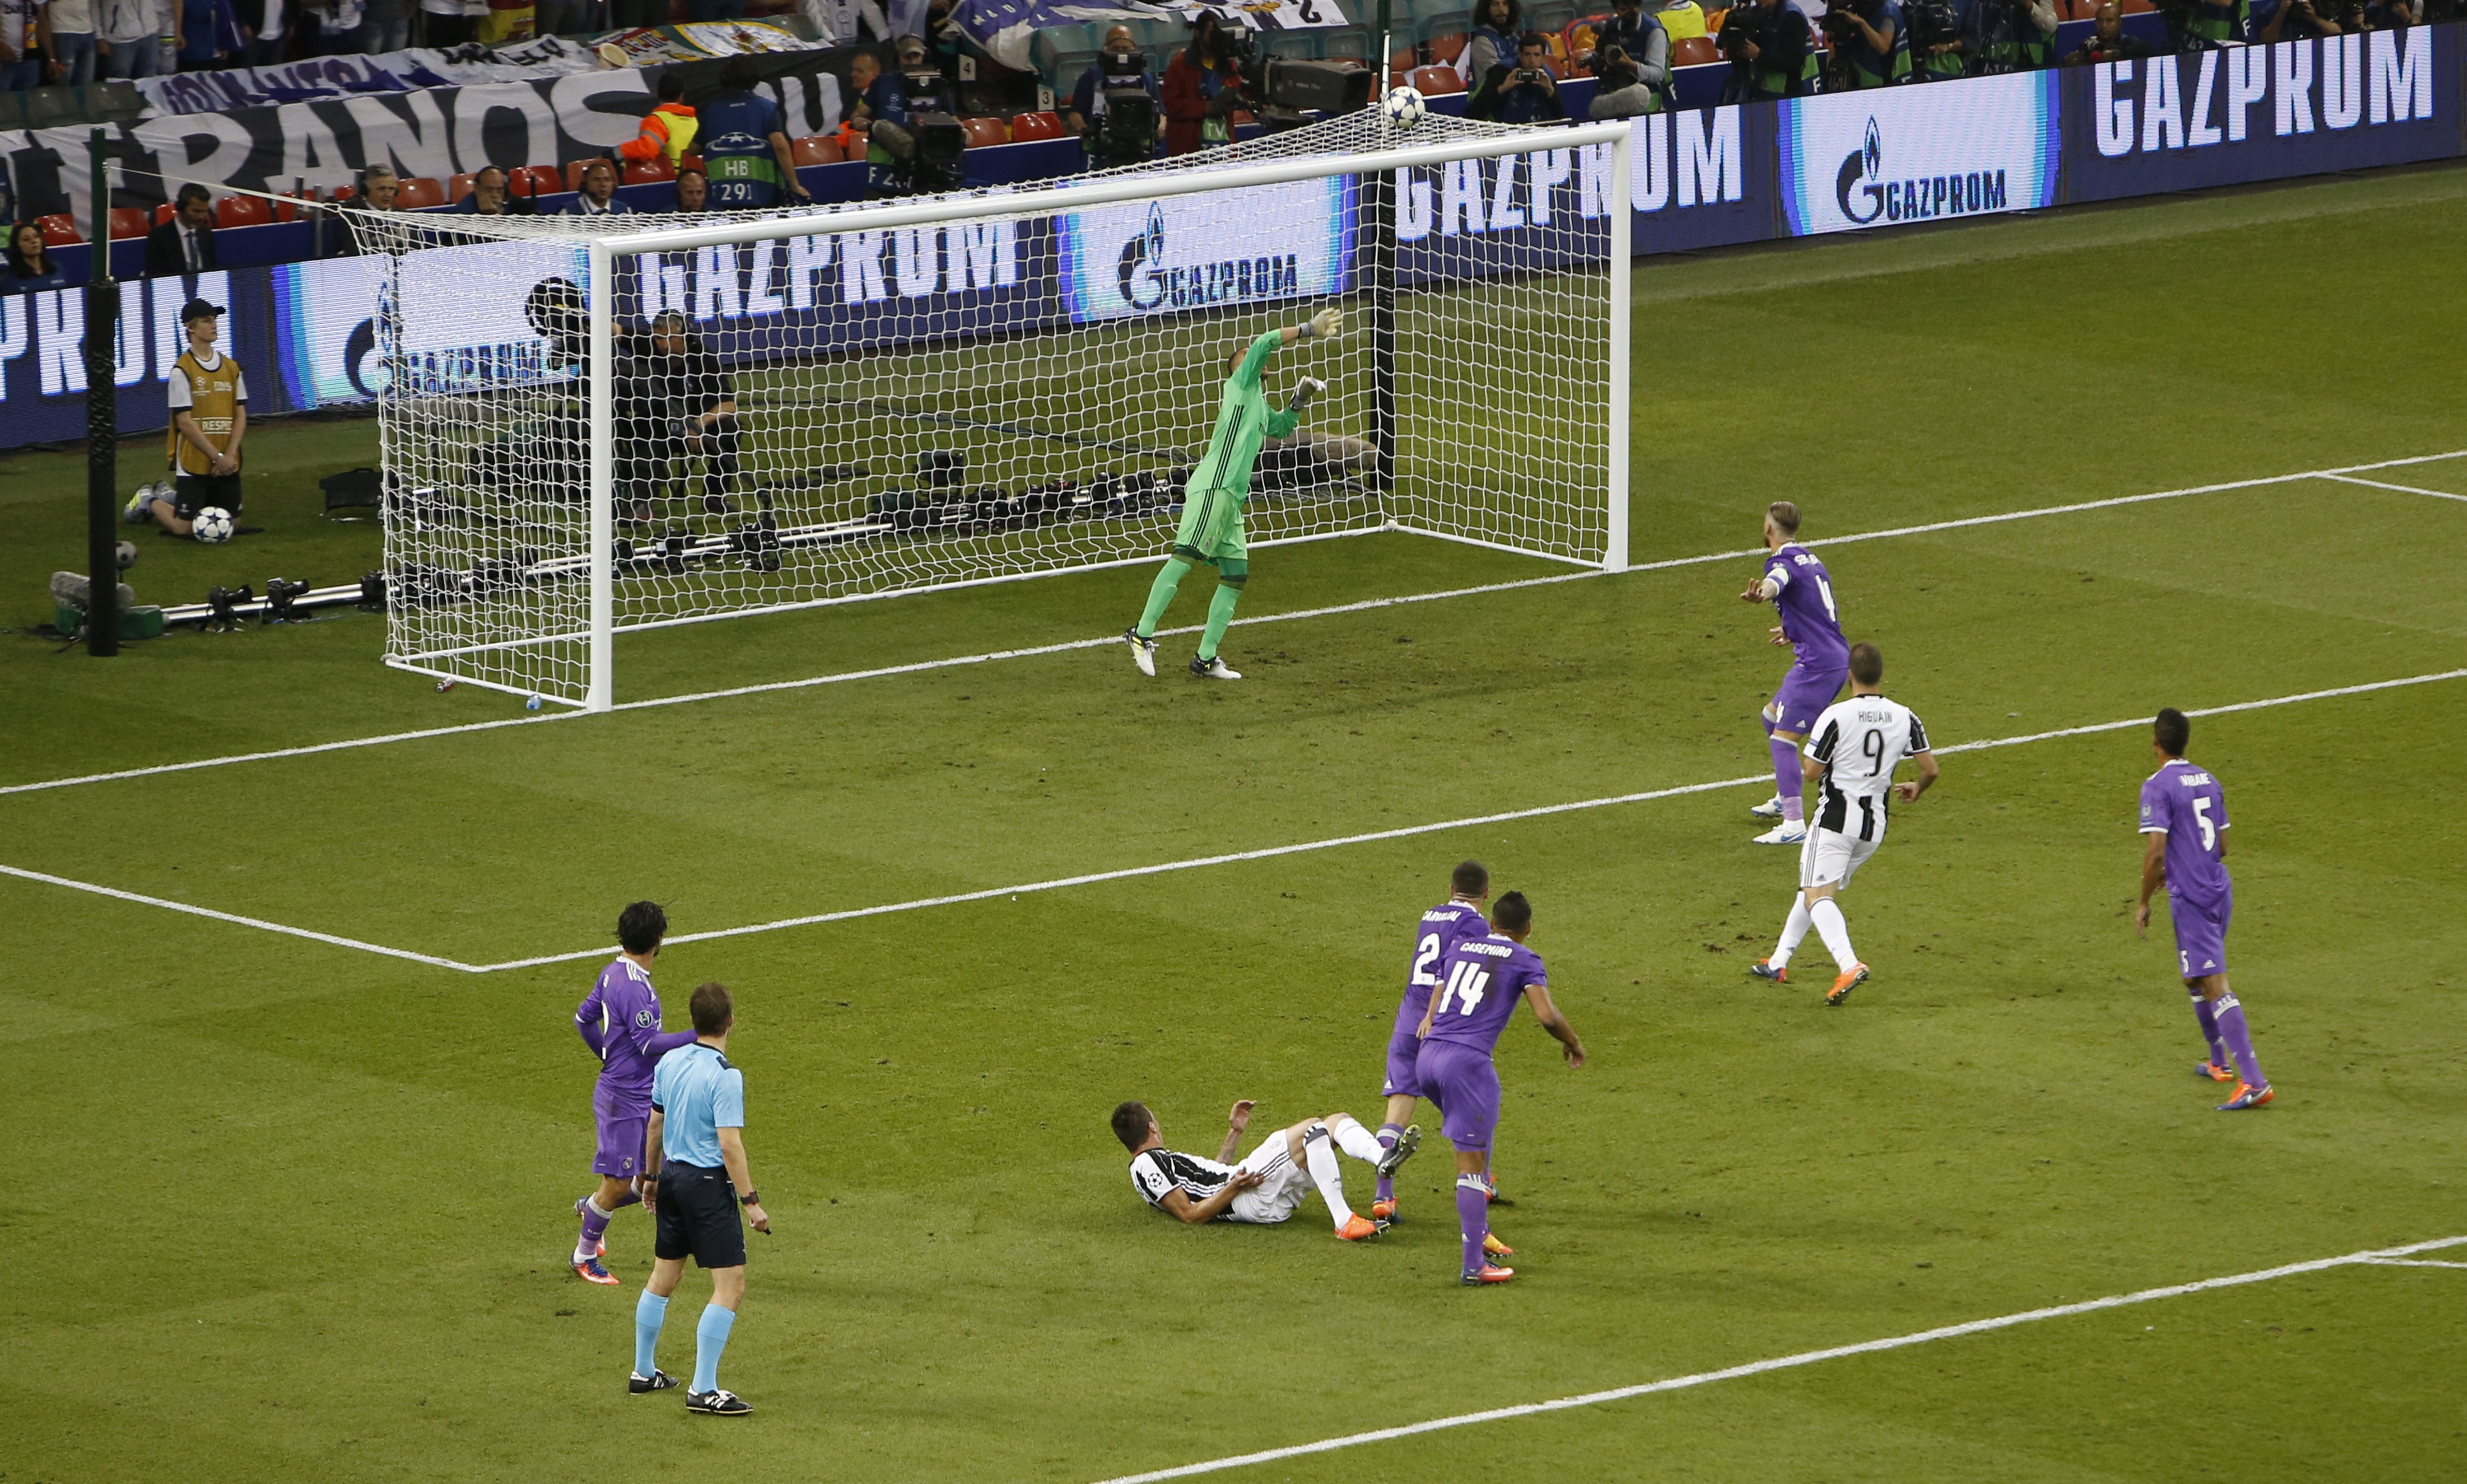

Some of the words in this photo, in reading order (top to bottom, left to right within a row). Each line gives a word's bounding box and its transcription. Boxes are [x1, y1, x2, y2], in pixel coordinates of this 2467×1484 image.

[963, 62, 971, 75] 4
[2094, 24, 2434, 158] GAZPROM
[1042, 91, 1050, 105] 3
[720, 183, 753, 201] 291
[724, 160, 749, 176] HB
[1886, 169, 2007, 221] GAZPROM
[640, 202, 1020, 326] GAZPROM
[1170, 254, 1297, 308] GAZPROM
[1815, 574, 1836, 622] 4
[1863, 729, 1885, 778] 9
[2192, 795, 2216, 851] 5
[1410, 932, 1442, 986] 2
[1459, 941, 1514, 959] CASEMIRO
[2180, 949, 2189, 973] 5
[1438, 960, 1491, 1017] 14
